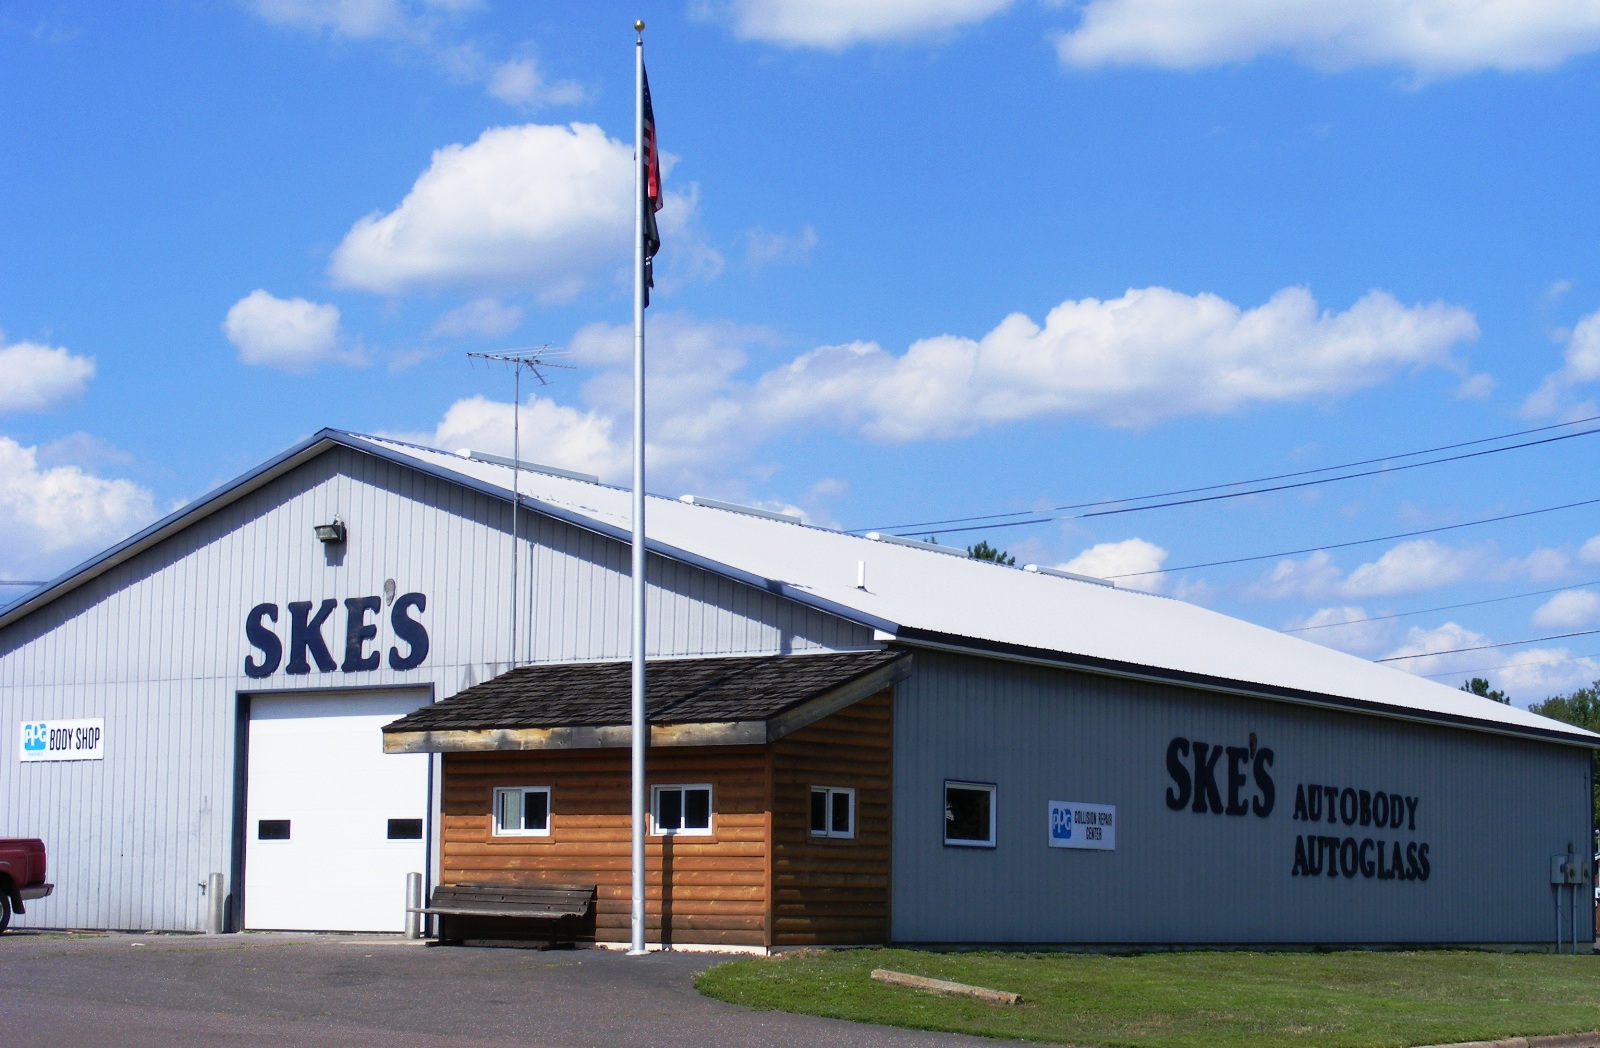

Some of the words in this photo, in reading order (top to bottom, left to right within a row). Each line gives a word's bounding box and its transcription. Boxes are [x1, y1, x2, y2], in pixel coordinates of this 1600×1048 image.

[244, 578, 430, 679] SKE'S
[25, 723, 47, 748] PPG
[49, 728, 74, 751] BODY
[76, 727, 101, 750] SHOP
[1166, 732, 1276, 818] SKE'S
[1074, 811, 1097, 825] COLLISION
[1098, 812, 1113, 827] REPAIR
[1292, 783, 1419, 831] AUTOBODY
[1053, 808, 1072, 836] PPG
[1086, 827, 1102, 840] CENTER
[1291, 835, 1431, 881] AUTOGLASS
